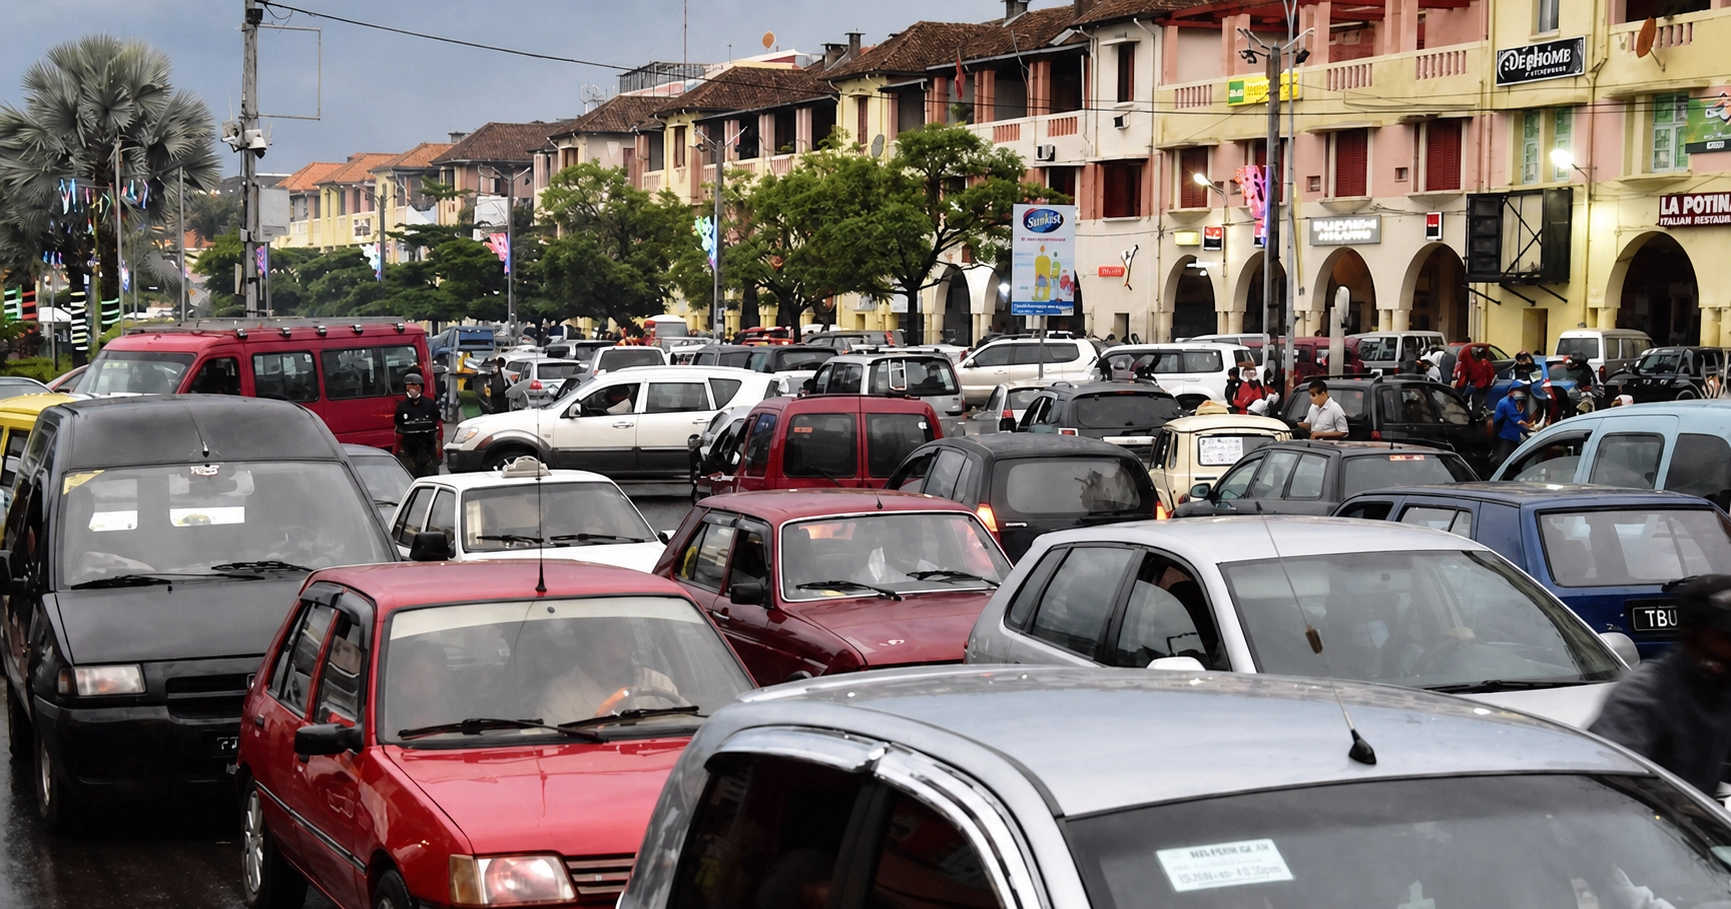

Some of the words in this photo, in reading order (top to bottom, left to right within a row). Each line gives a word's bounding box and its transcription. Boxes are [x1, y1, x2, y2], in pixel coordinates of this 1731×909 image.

[1661, 196, 1679, 215] LA
[1683, 194, 1731, 214] POTIN
[1660, 217, 1691, 226] ITALIAN
[1645, 610, 1677, 627] TBU
